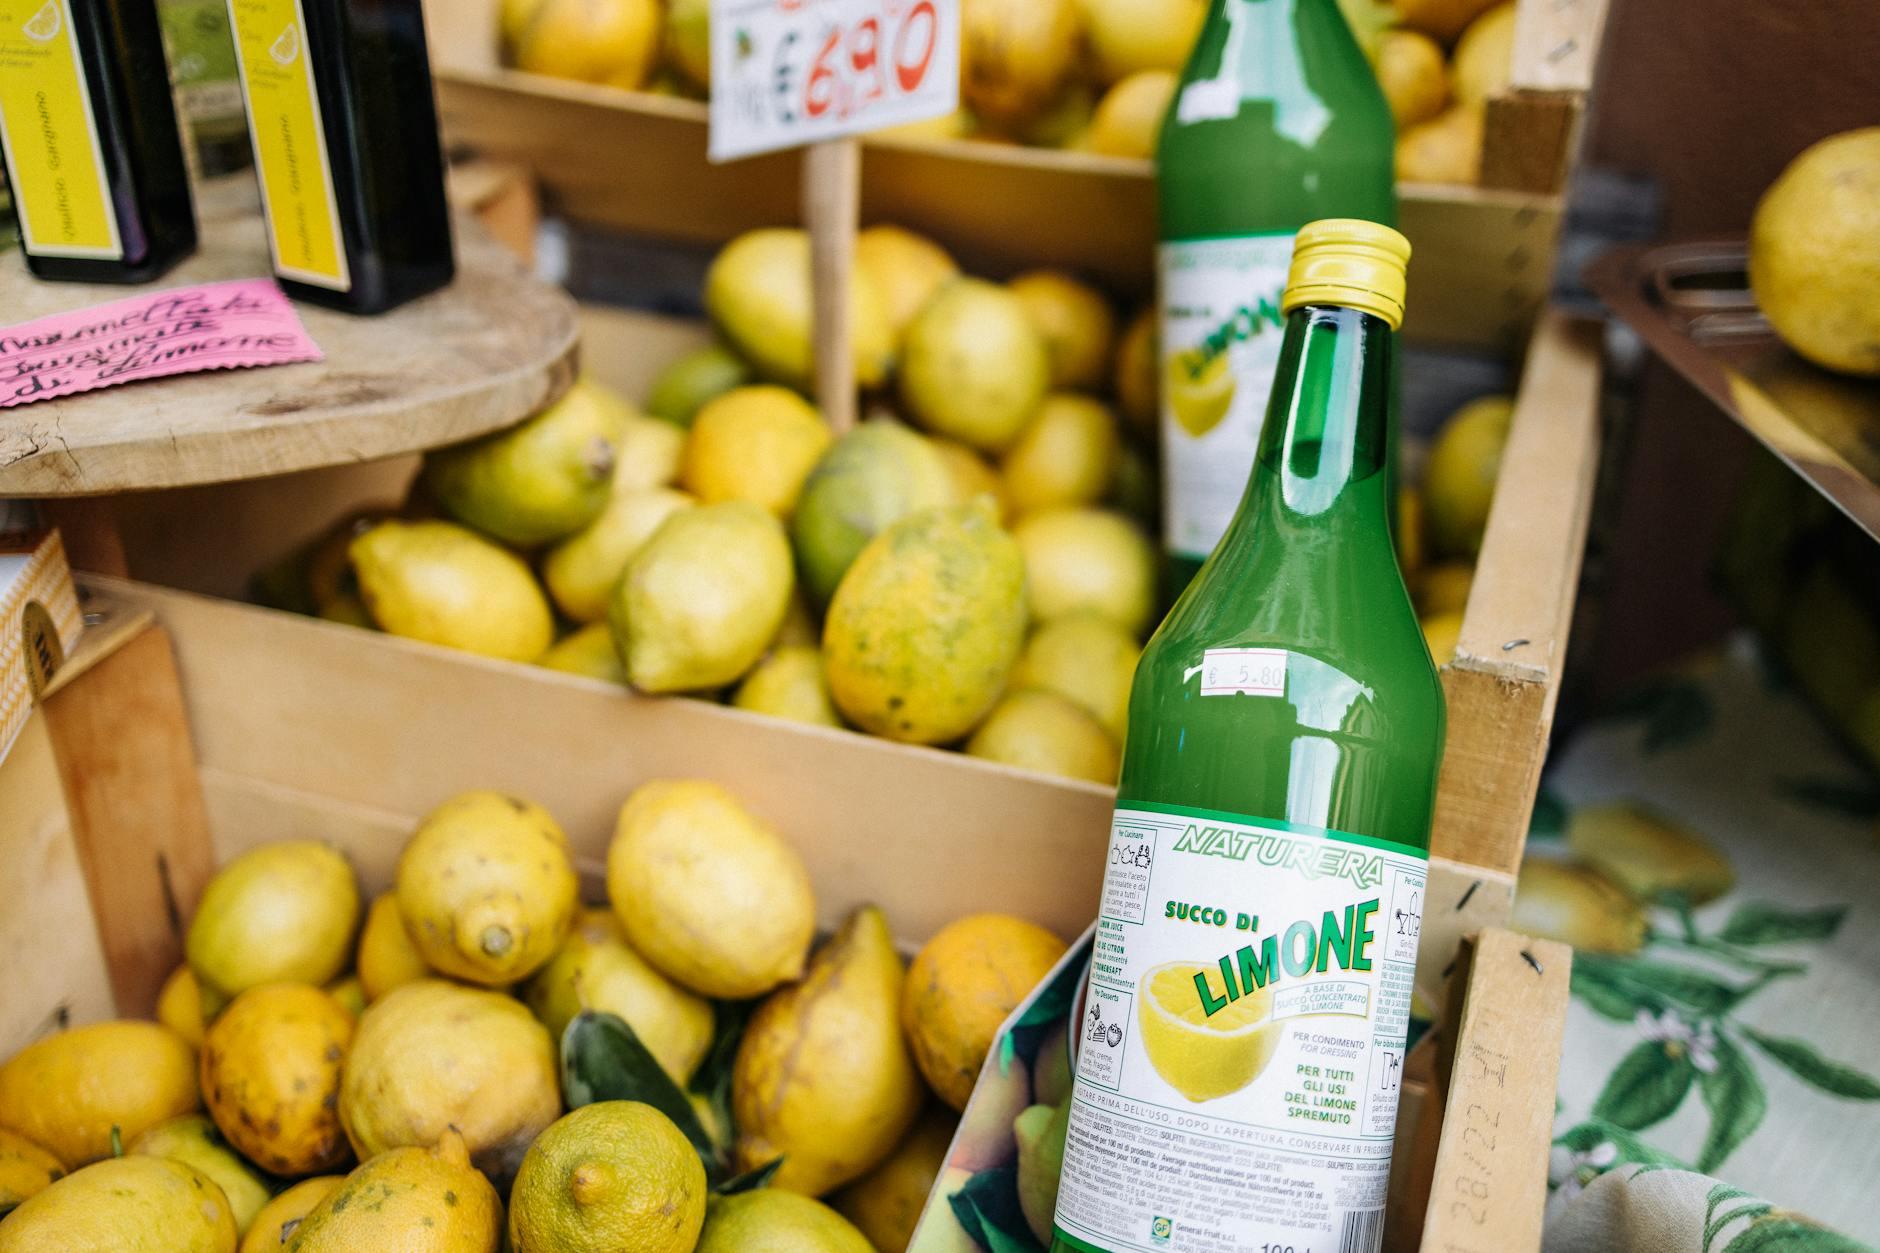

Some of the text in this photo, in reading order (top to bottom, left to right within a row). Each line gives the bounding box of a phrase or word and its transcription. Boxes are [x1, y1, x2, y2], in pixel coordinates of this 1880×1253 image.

[1239, 665, 1283, 687] 5.80
[1173, 824, 1385, 890] NATURERA
[1165, 900, 1260, 933] SUCCO DI
[1107, 944, 1125, 954] CITRON
[1193, 898, 1380, 1018] LIMONE
[1100, 990, 1119, 1002] Desserts
[1313, 984, 1335, 993] BASE
[1336, 983, 1346, 992] DI
[1309, 993, 1367, 1004] CONCENTRATO
[1300, 1002, 1345, 1013] DI LIMONE
[1293, 1031, 1365, 1049] PER CONDIMENTO
[1300, 1043, 1357, 1059] FOR DRESSING
[1297, 1064, 1354, 1081] PER TUTTI
[1303, 1081, 1345, 1095] GLI USI
[1285, 1092, 1357, 1111] DEL LIMONE
[1288, 1107, 1351, 1124] SPREMUTO
[1098, 1095, 1121, 1110] PRIMA
[1124, 1103, 1172, 1124] DELL'USO,
[1177, 1117, 1209, 1132] DOPO
[1214, 1125, 1284, 1145] L'APERTURA
[1289, 1137, 1350, 1153] CONSERVARE
[1353, 1145, 1361, 1154] IN
[1116, 1152, 1129, 1162] pour
[1130, 1155, 1140, 1165] 100
[1141, 1159, 1149, 1167] ml
[1149, 1161, 1158, 1169] de
[1304, 1190, 1315, 1199] 100
[1315, 1191, 1323, 1200] ml
[1161, 1153, 1187, 1167] Average
[1188, 1161, 1222, 1174] nutritional
[1224, 1168, 1245, 1178] values
[1247, 1172, 1257, 1181] per
[1260, 1174, 1271, 1183] 100
[1272, 1176, 1281, 1184] ml
[1154, 1222, 1168, 1232] GF
[1176, 1222, 1202, 1236] General
[1203, 1229, 1221, 1240] Fruit
